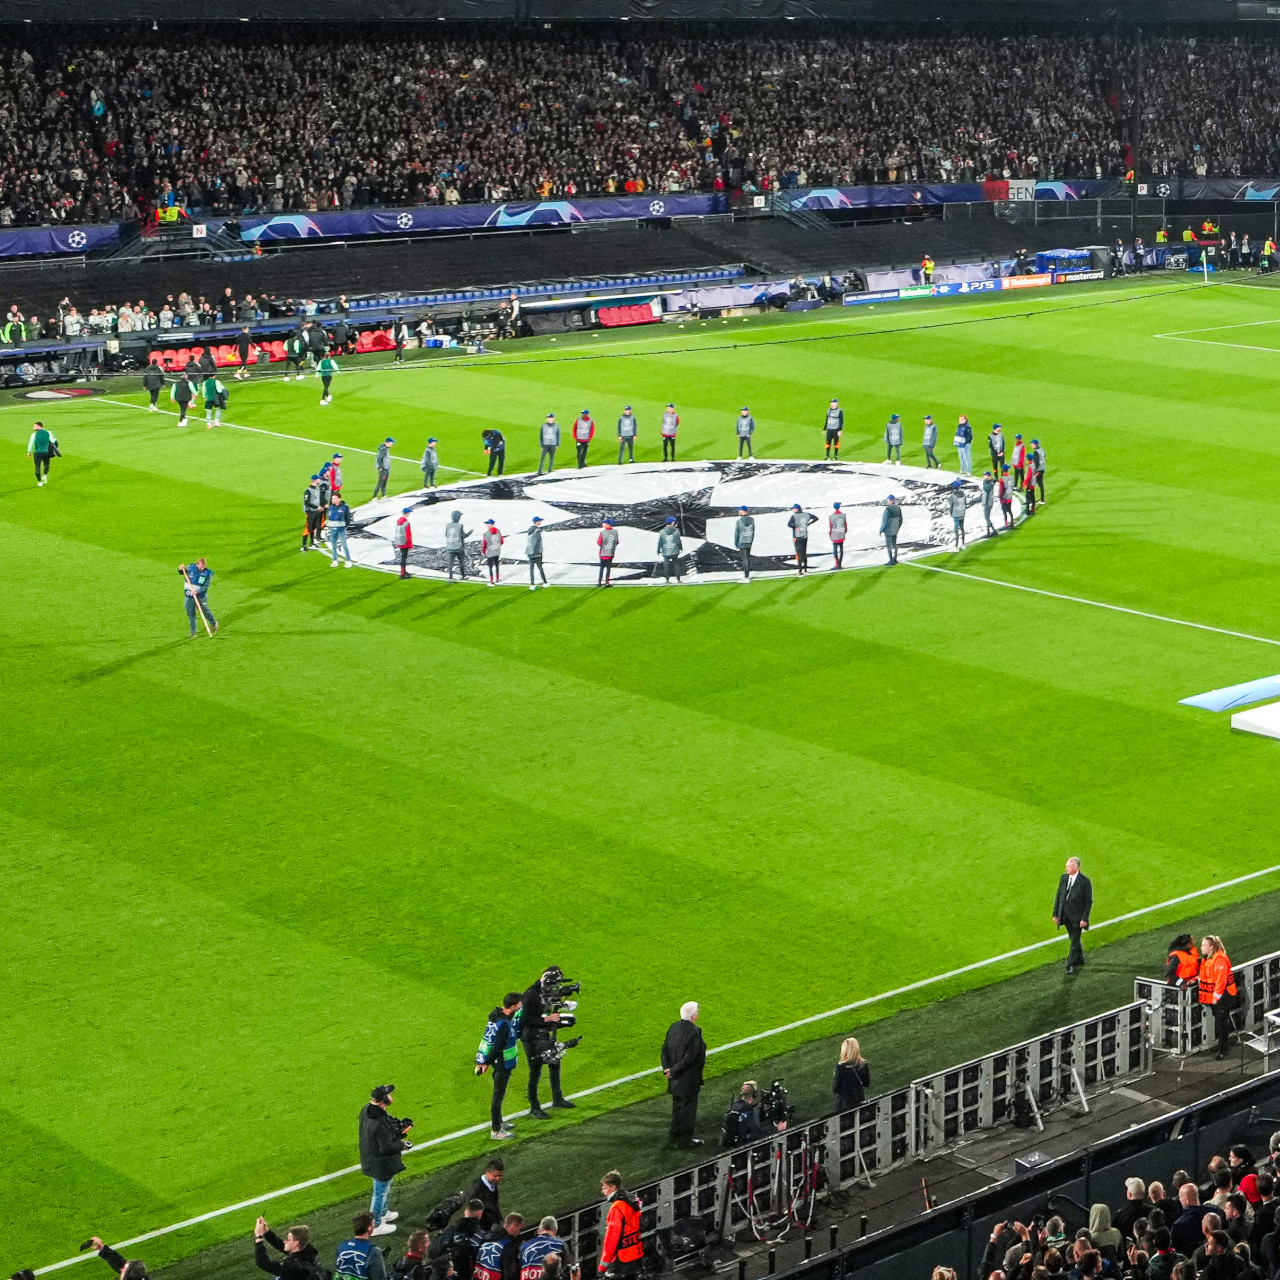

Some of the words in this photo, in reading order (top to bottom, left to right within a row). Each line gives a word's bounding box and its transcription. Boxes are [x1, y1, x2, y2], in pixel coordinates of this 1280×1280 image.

[196, 227, 203, 235] N
[1066, 271, 1104, 282] mastercard
[970, 281, 995, 290] PS5
